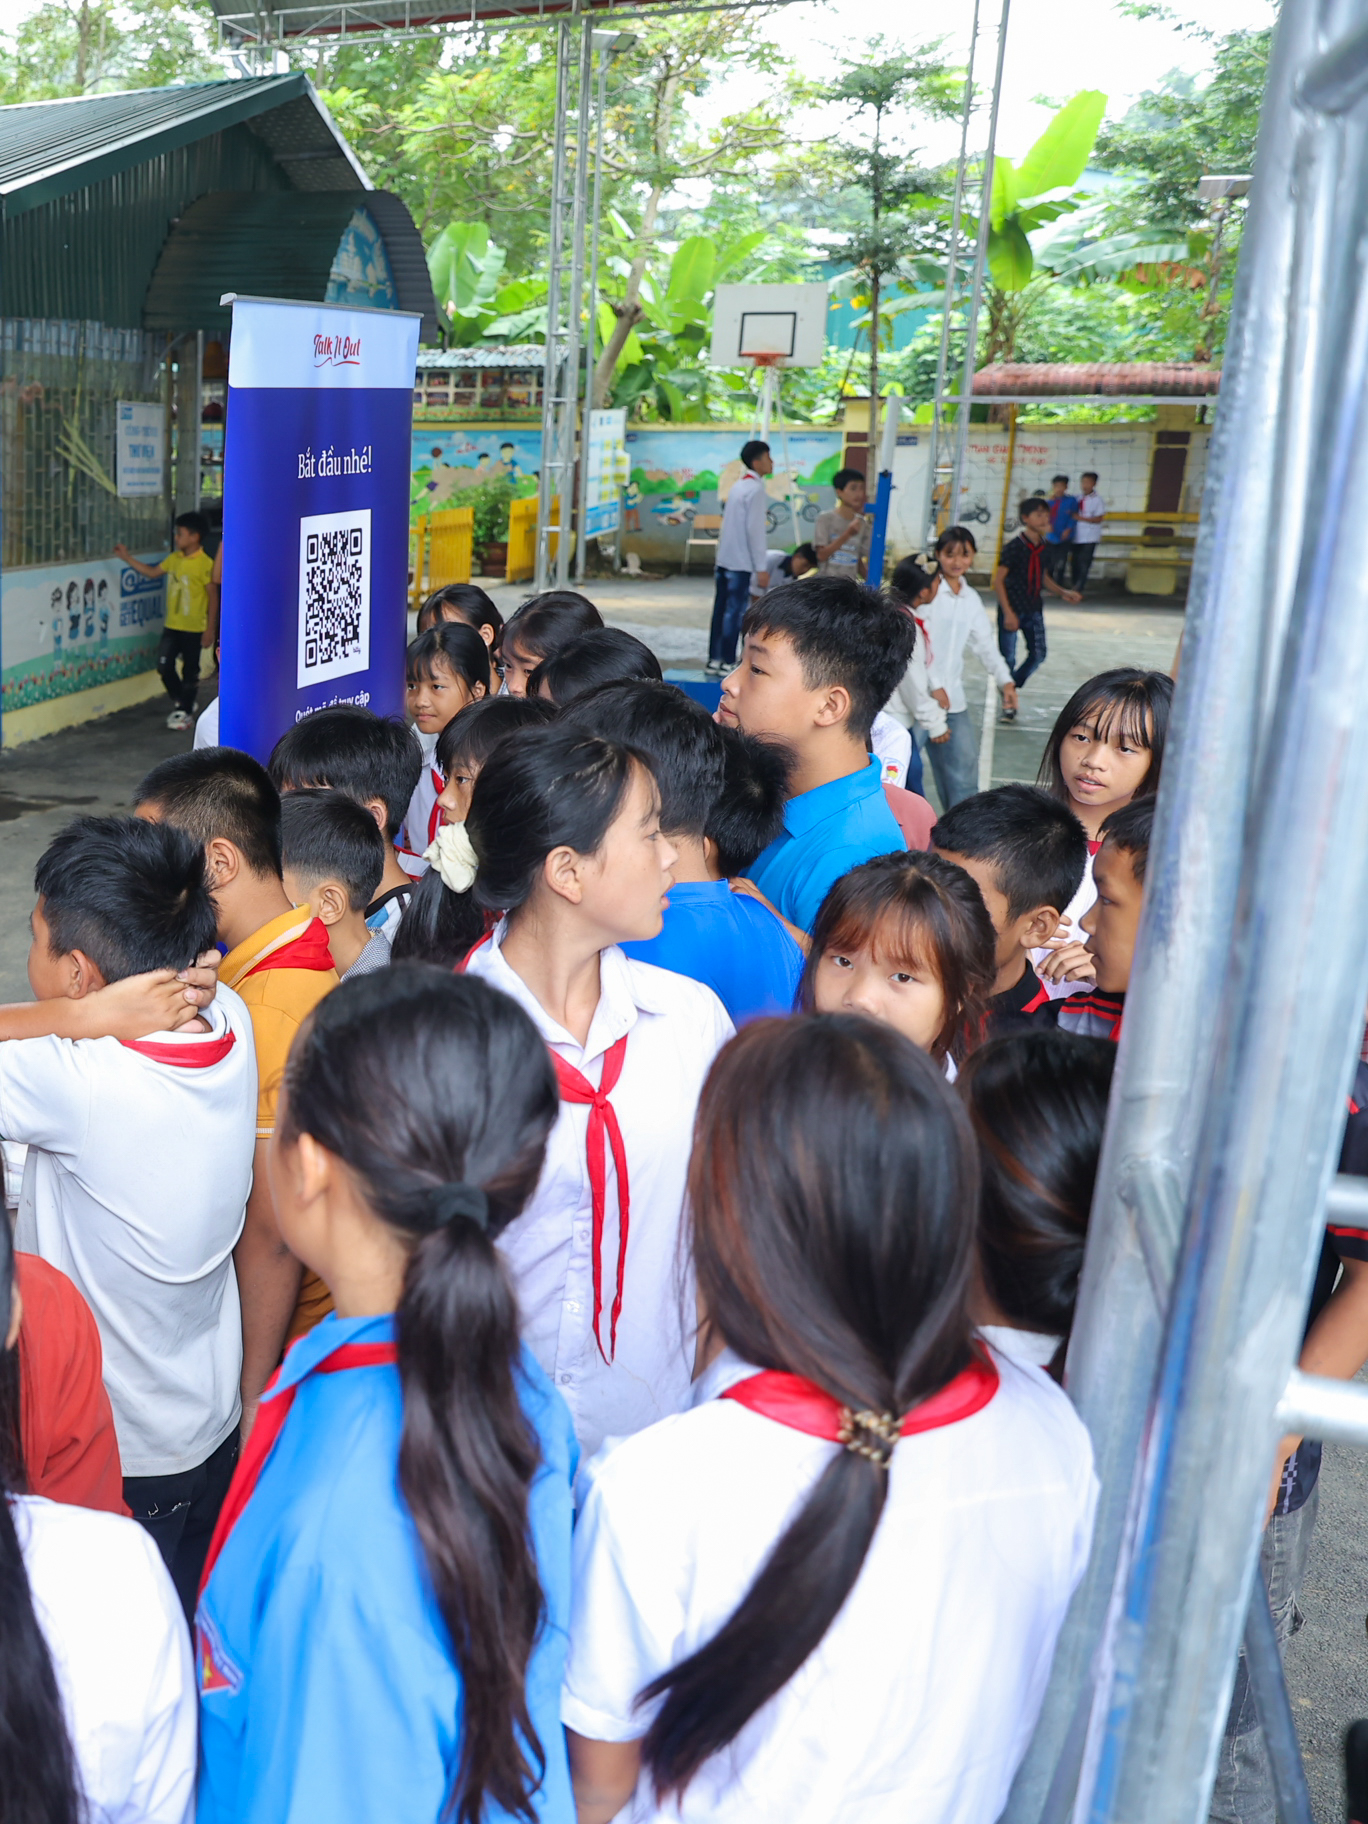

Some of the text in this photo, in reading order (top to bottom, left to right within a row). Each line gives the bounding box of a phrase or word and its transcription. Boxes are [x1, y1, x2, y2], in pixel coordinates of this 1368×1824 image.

[313, 334, 361, 359] Talk It Out
[297, 445, 372, 479] Bắt đầu nhé!
[354, 690, 370, 708] cập
